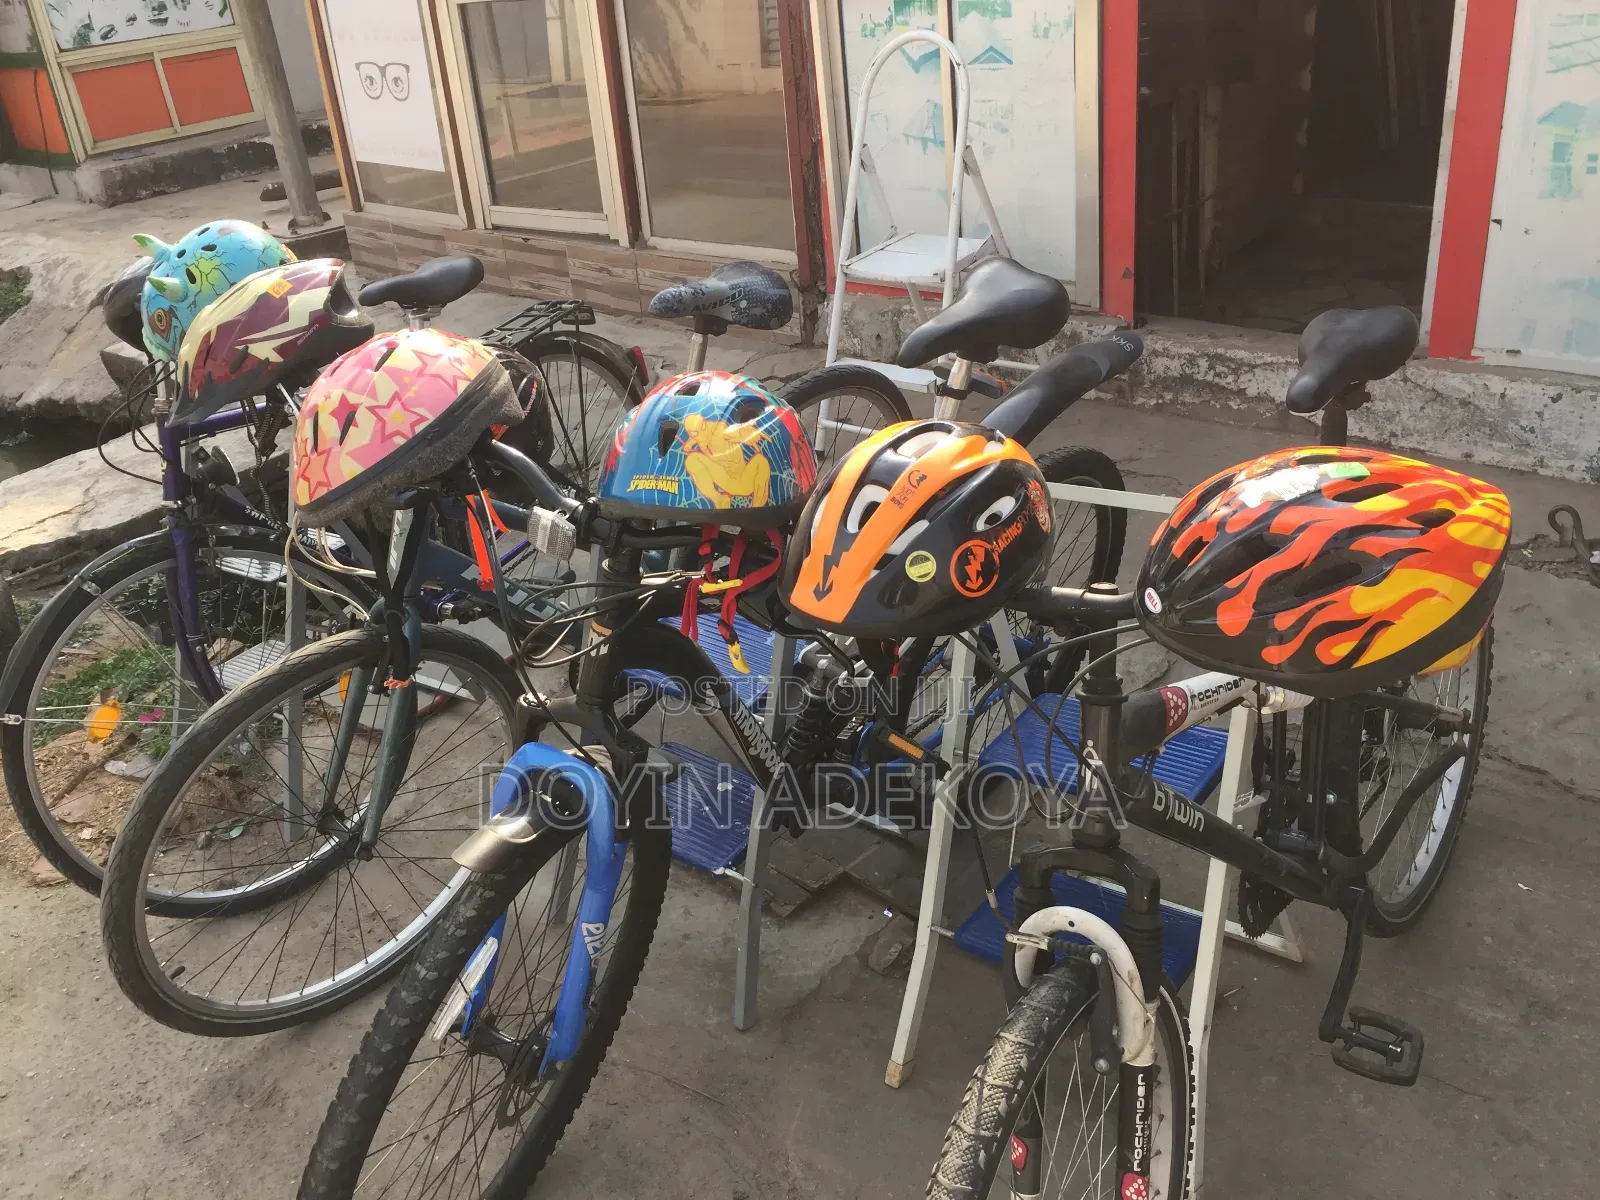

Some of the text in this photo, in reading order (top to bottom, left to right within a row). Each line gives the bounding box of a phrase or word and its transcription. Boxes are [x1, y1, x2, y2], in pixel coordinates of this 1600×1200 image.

[690, 287, 744, 313] AVIGO
[626, 479, 678, 494] SPIDER-MAN
[890, 496, 904, 510] BOYS
[1146, 591, 1158, 610] BELL
